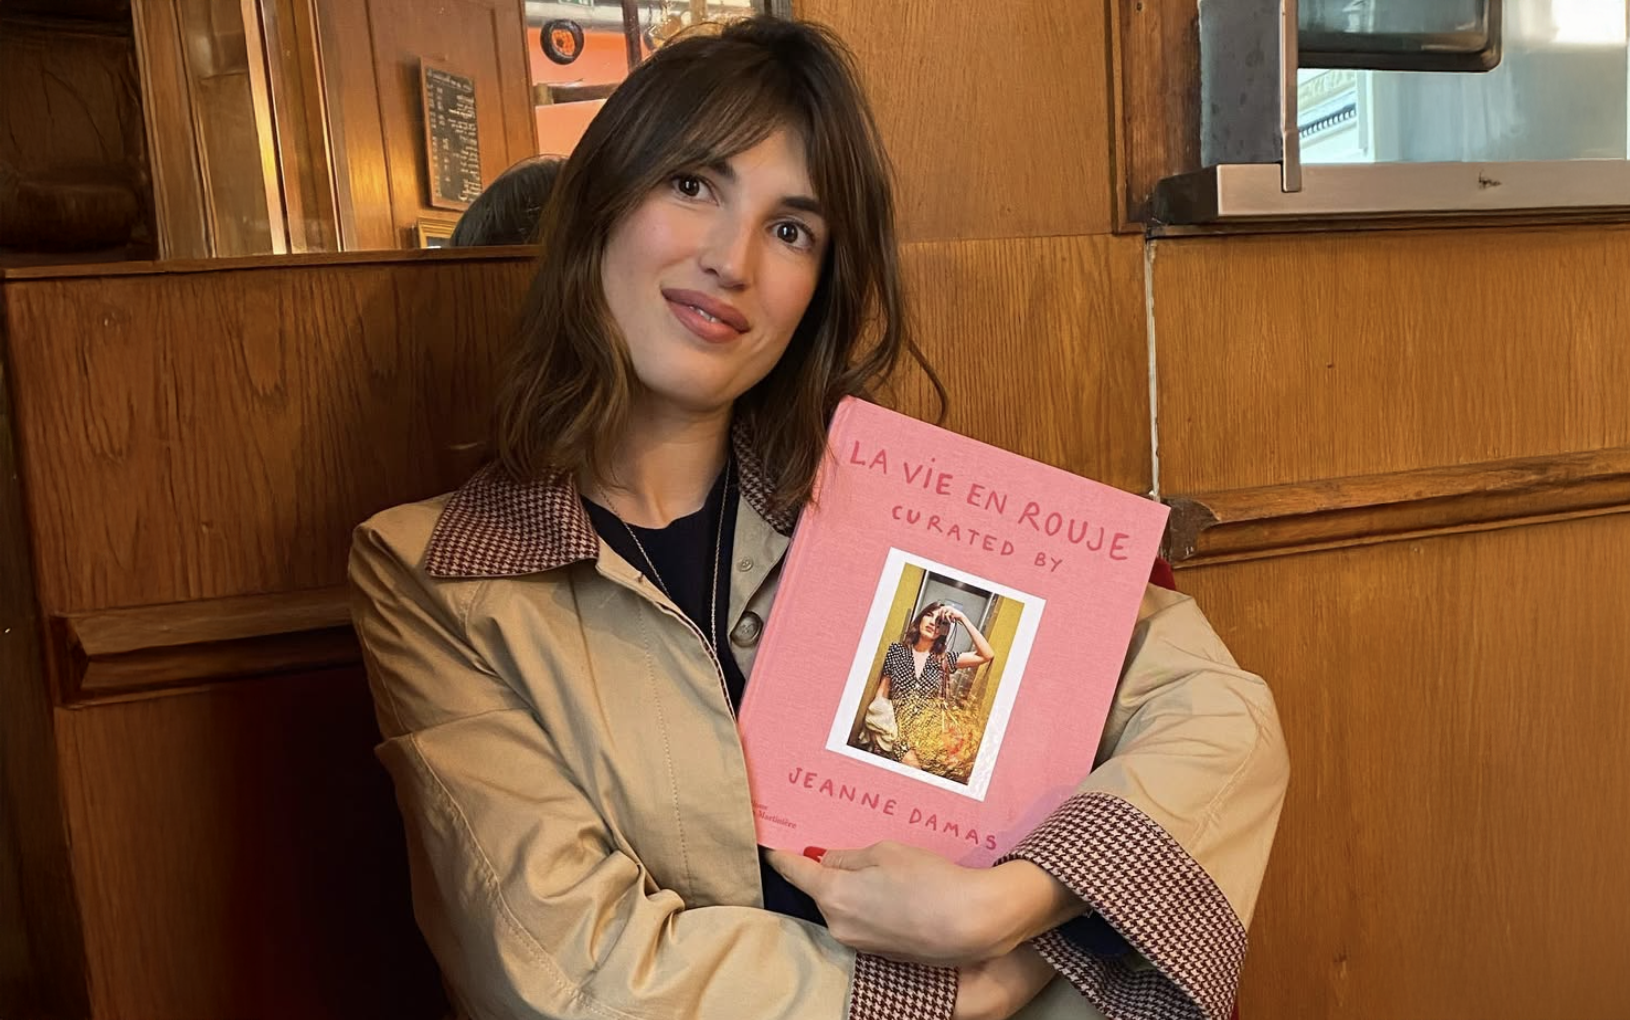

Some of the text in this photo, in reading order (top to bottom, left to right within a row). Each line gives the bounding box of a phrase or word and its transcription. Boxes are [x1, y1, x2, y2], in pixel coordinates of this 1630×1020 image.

[849, 440, 888, 475] LA
[966, 482, 1008, 515] EN
[1017, 501, 1131, 561] ROUJE
[891, 505, 1064, 573] CURATED BY
[787, 766, 998, 851] JEANNE DAMAS
